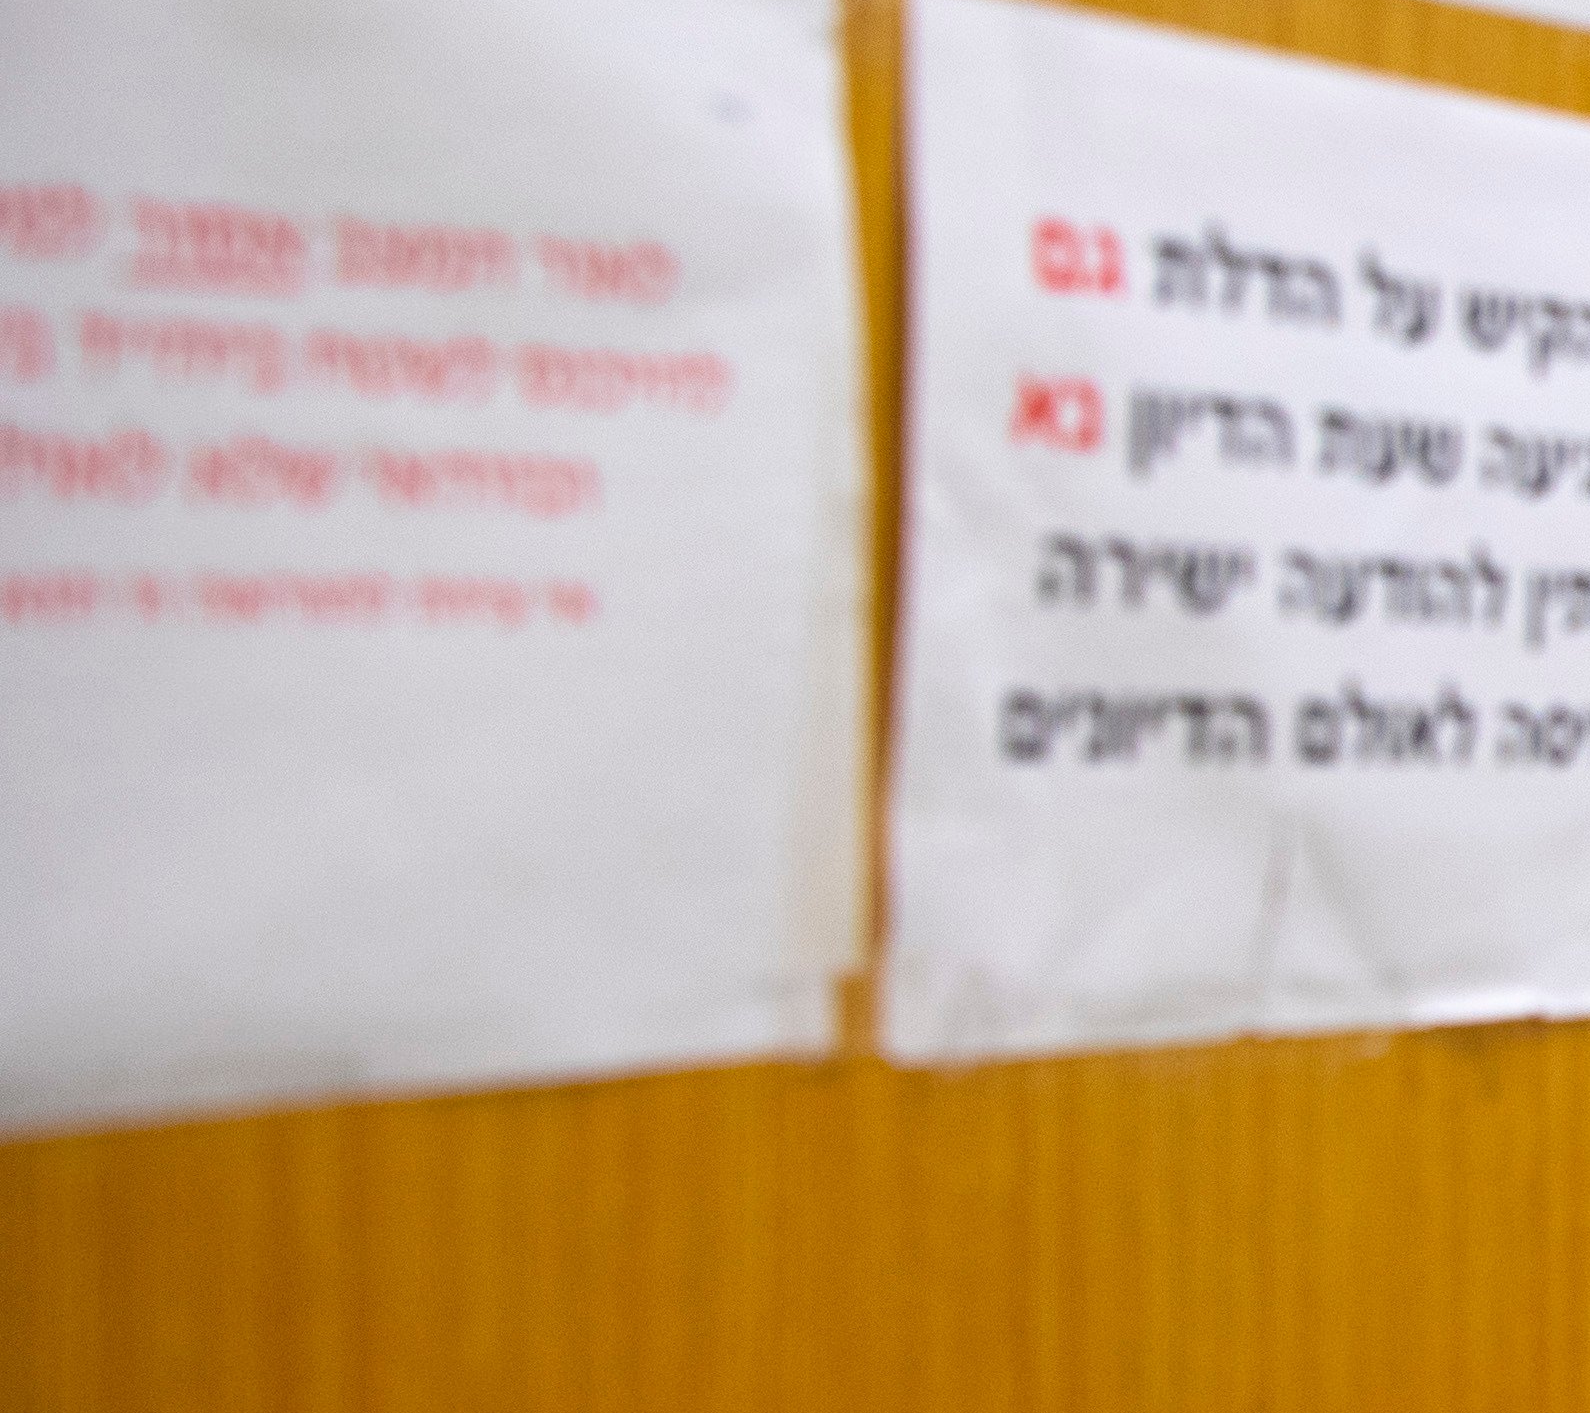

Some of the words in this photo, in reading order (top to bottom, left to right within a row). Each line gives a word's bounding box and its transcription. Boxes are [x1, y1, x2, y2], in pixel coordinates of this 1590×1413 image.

[1032, 215, 1126, 297] גם
[1151, 219, 1340, 323] הדלת
[1359, 249, 1441, 348] על
[1127, 387, 1294, 477] הדיון
[1317, 404, 1463, 487] שעת
[1035, 530, 1255, 617] ישירה
[1280, 542, 1509, 627] להודעה
[999, 686, 1273, 766] הדיונים
[1293, 679, 1478, 767] לאולם
